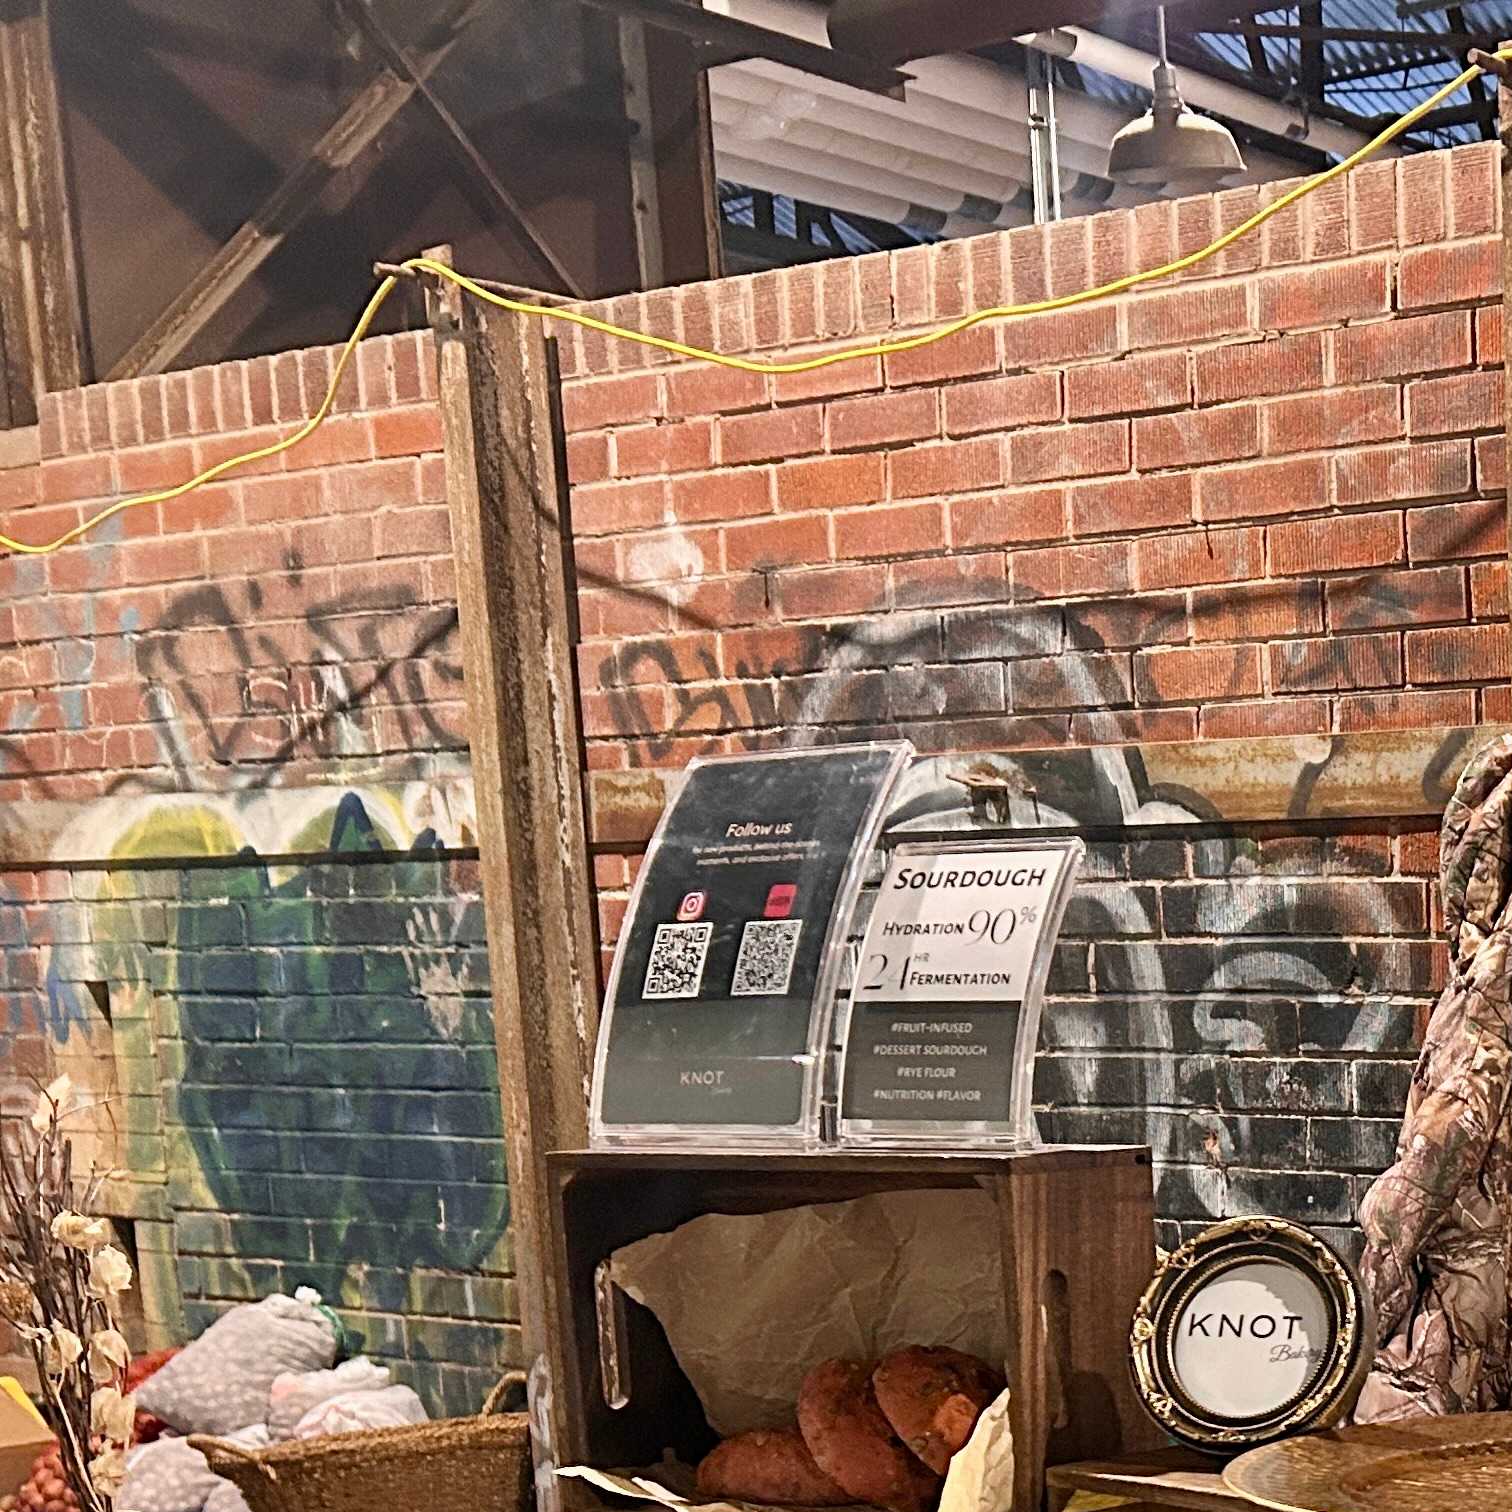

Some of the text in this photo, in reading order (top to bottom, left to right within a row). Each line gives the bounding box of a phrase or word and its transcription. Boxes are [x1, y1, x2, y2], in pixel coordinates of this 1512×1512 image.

[725, 822, 793, 838] Follow us
[893, 867, 1047, 890] SOURDOUGH
[882, 921, 965, 937] HYDRATION
[909, 970, 1012, 986] FERMENTATION
[891, 1021, 974, 1035] #FRUIT-INFUSED
[873, 1044, 988, 1057] #DESSERT SOURDOUGH
[680, 1070, 725, 1086] KNOT
[897, 1066, 957, 1079] #RYE FLOUR
[873, 1089, 983, 1102] #NUTRITION #FLAVOR
[1188, 1312, 1304, 1341] KNOT
